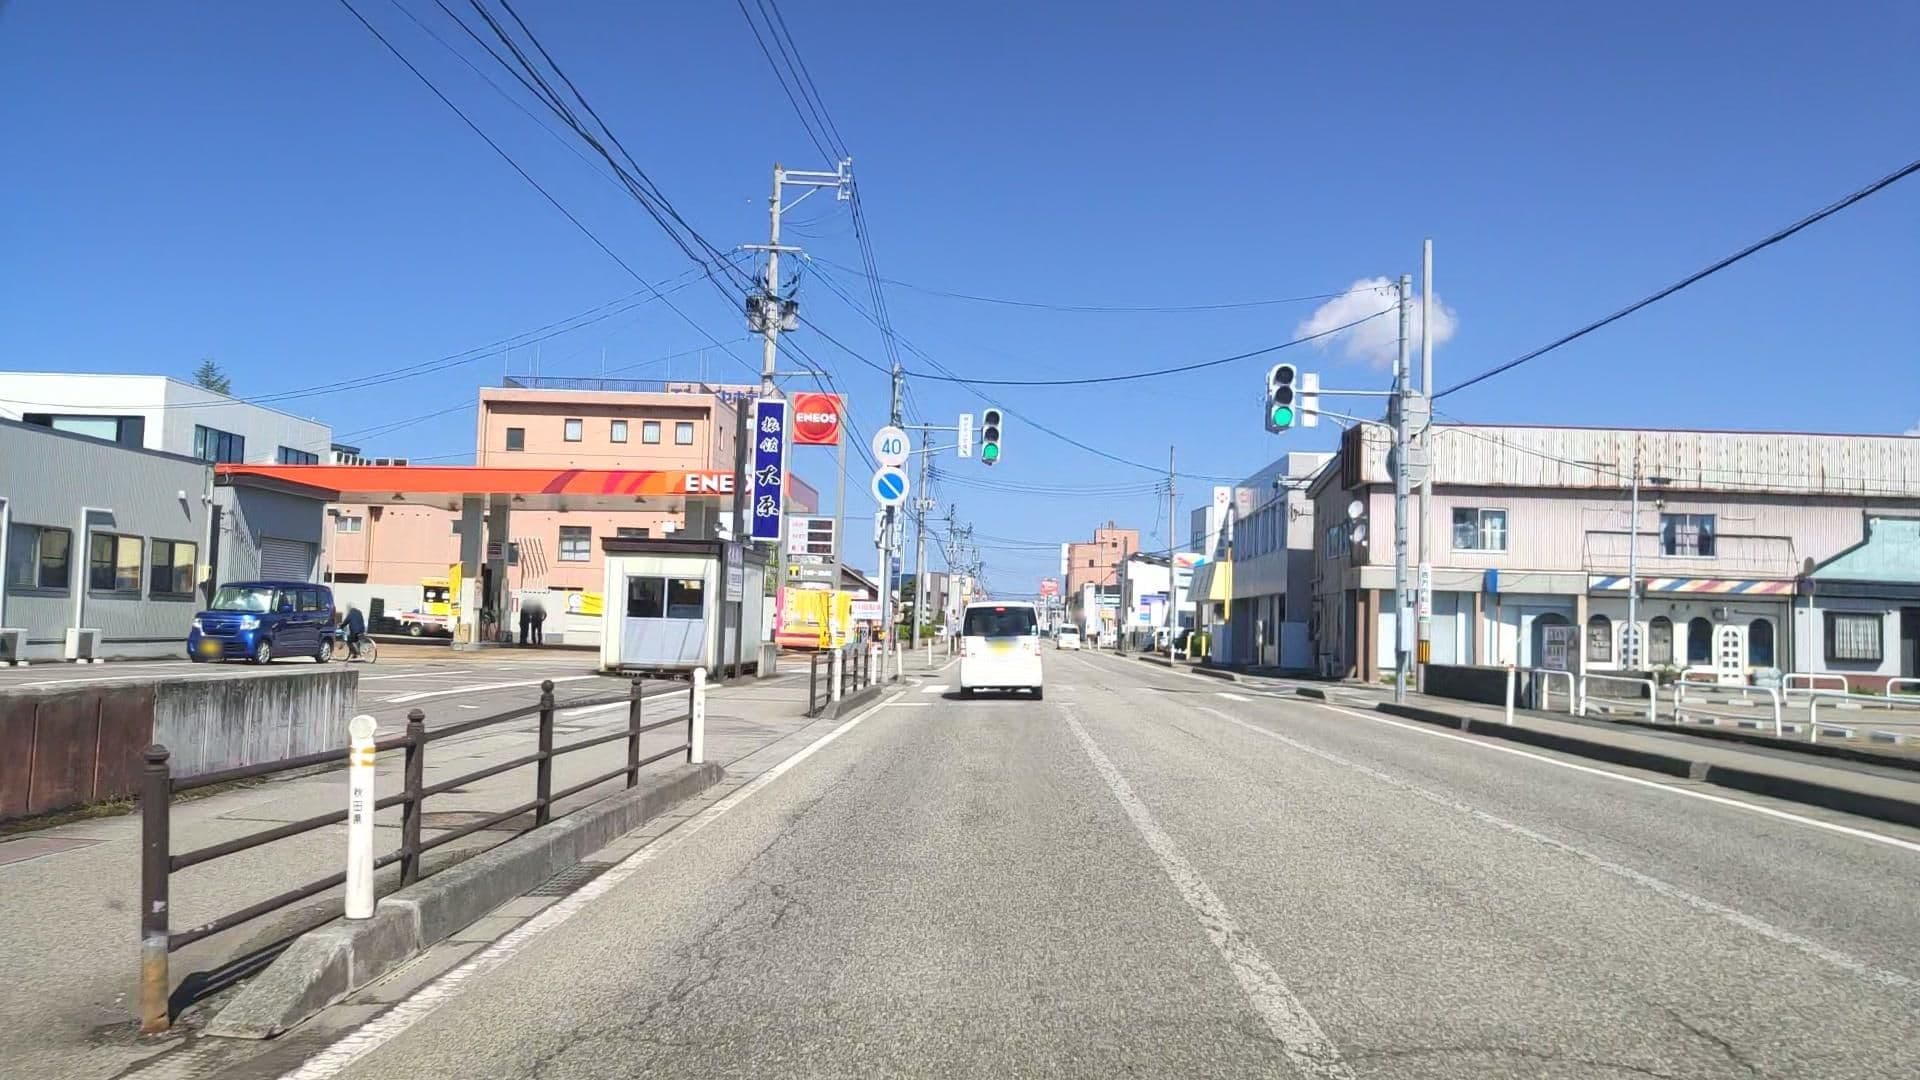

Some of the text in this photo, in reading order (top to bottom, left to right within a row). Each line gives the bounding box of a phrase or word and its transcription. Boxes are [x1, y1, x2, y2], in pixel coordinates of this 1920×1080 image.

[796, 413, 837, 423] ENEOS
[882, 438, 901, 454] 40
[352, 786, 365, 824] 秋田県
